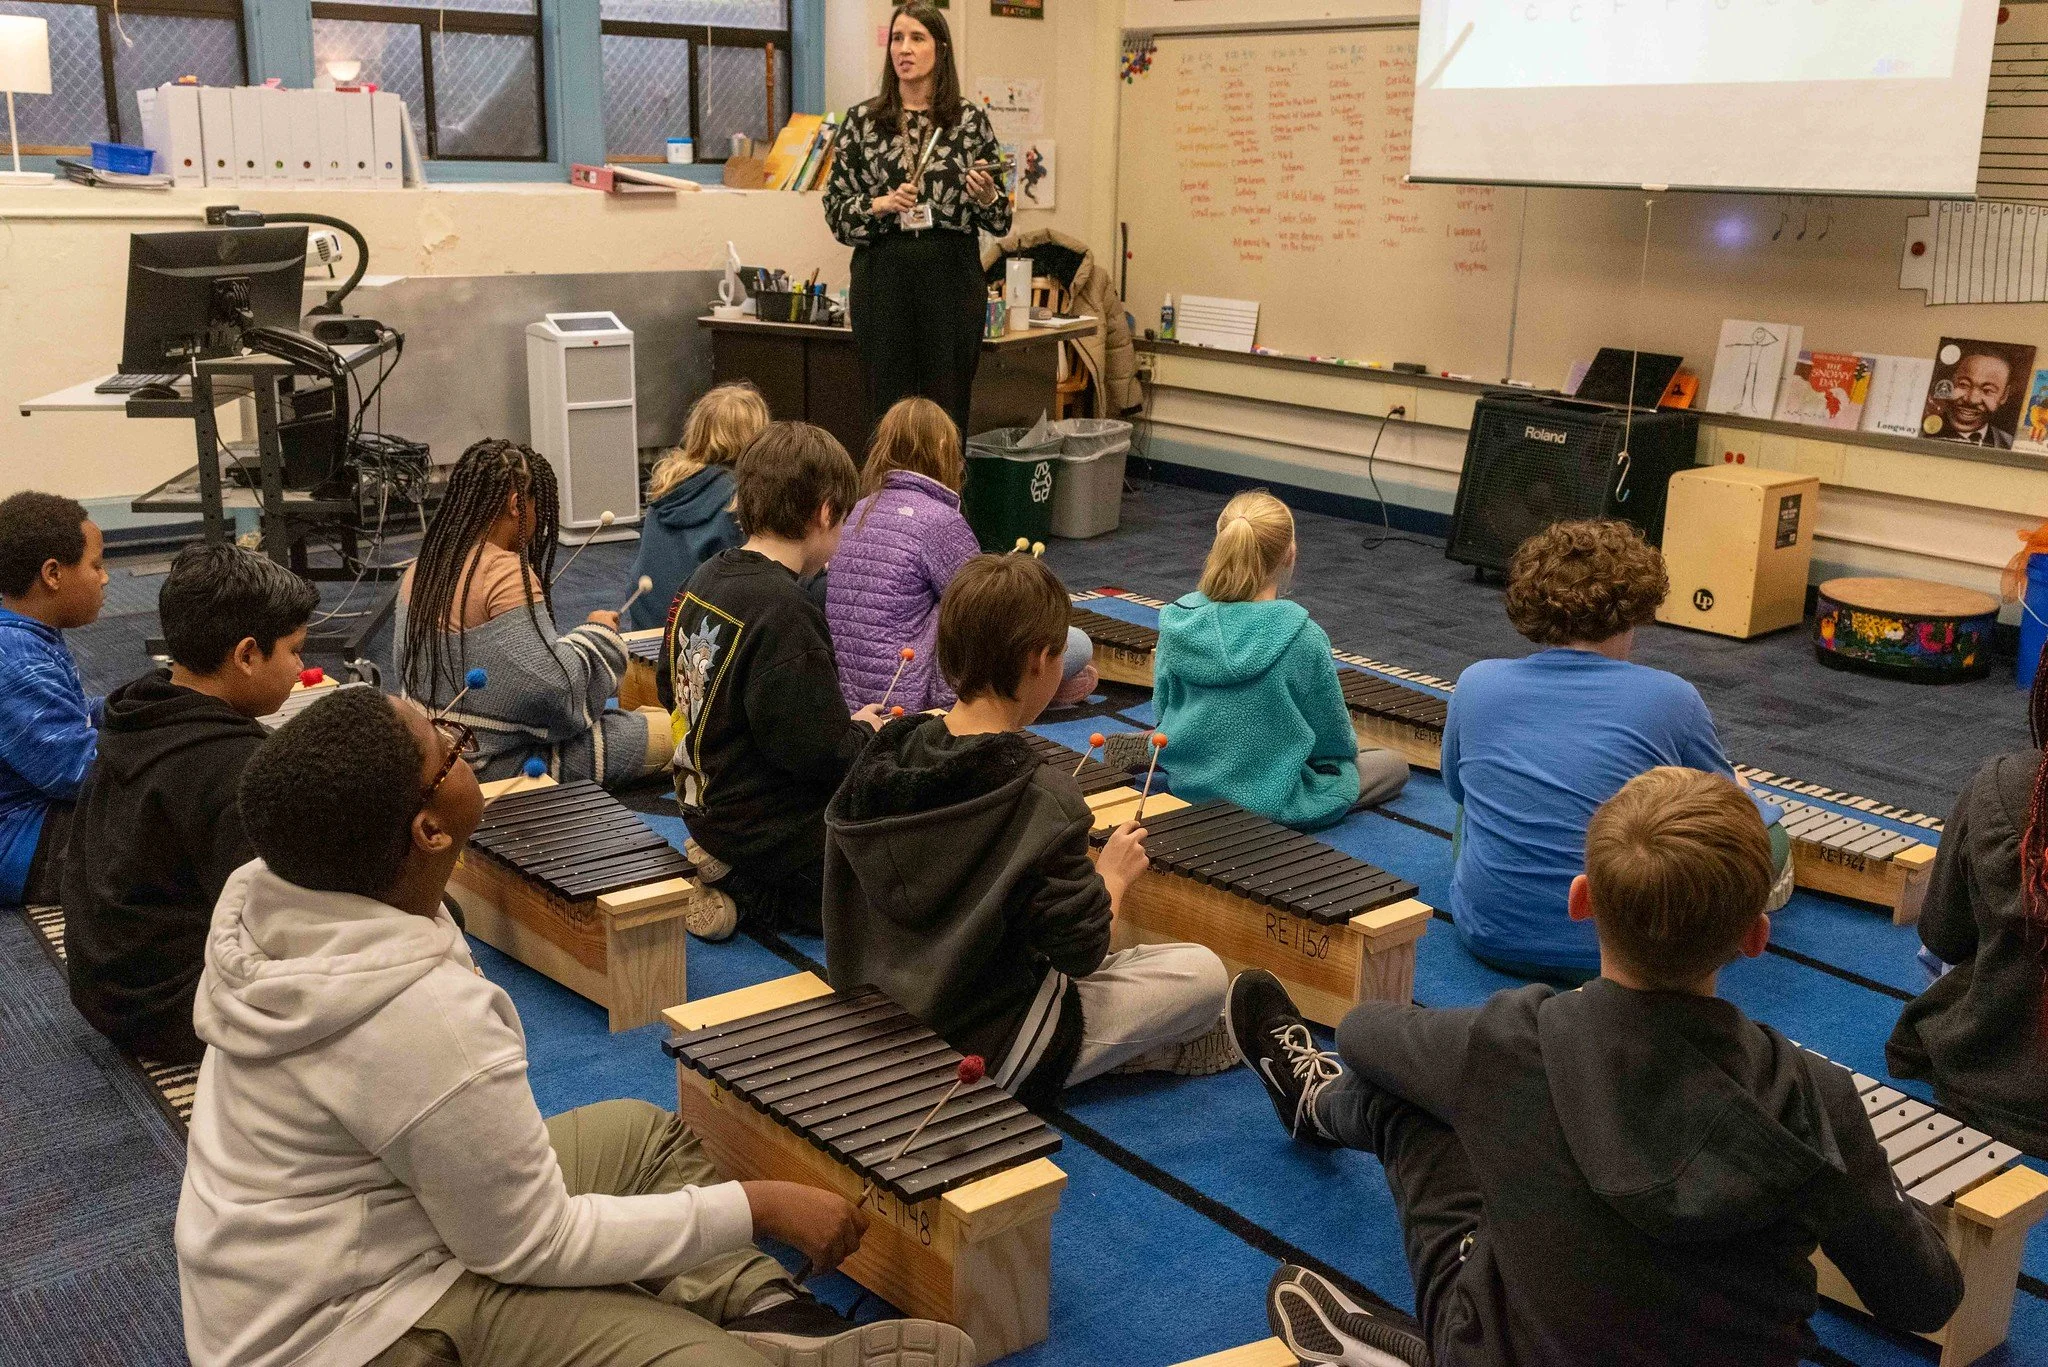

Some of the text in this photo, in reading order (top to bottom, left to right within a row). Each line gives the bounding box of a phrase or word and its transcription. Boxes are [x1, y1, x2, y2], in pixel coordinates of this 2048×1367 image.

[1811, 369, 1852, 380] SNOWY
[1819, 378, 1841, 387] DAY
[1877, 420, 1917, 434] Longway
[1524, 425, 1567, 444] Roland
